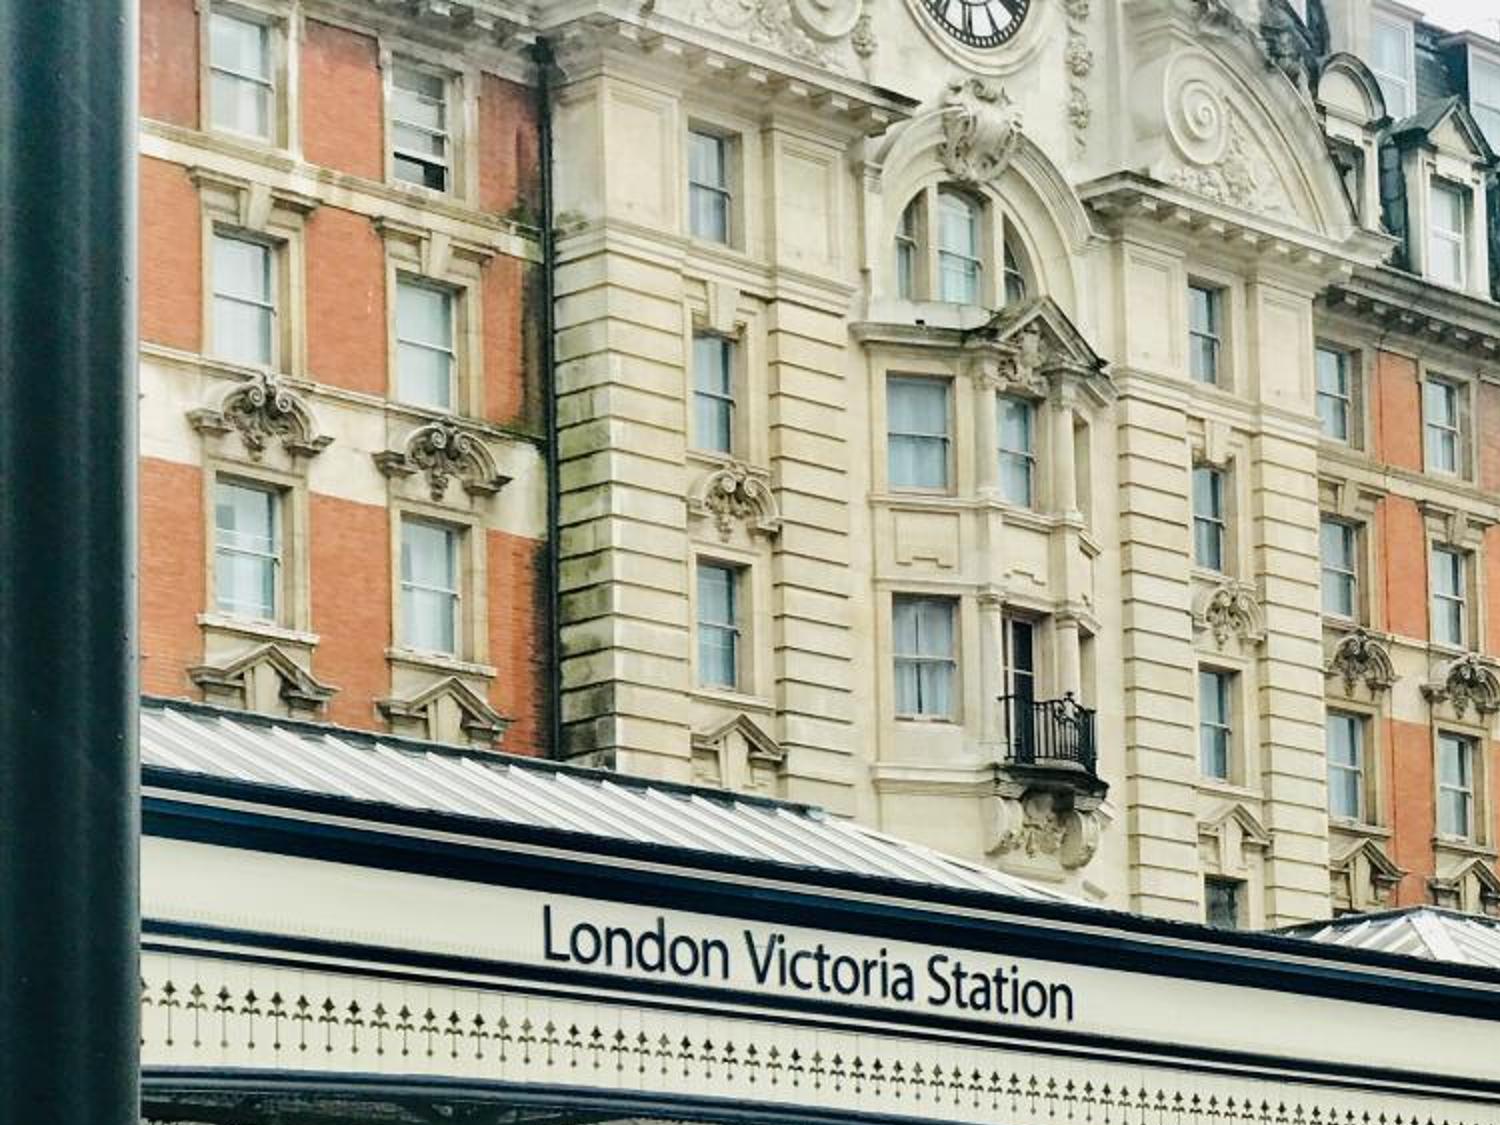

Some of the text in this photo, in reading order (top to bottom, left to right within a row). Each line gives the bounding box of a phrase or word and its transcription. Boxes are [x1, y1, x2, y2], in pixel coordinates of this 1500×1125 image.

[543, 905, 1074, 1021] London Victoria Station
